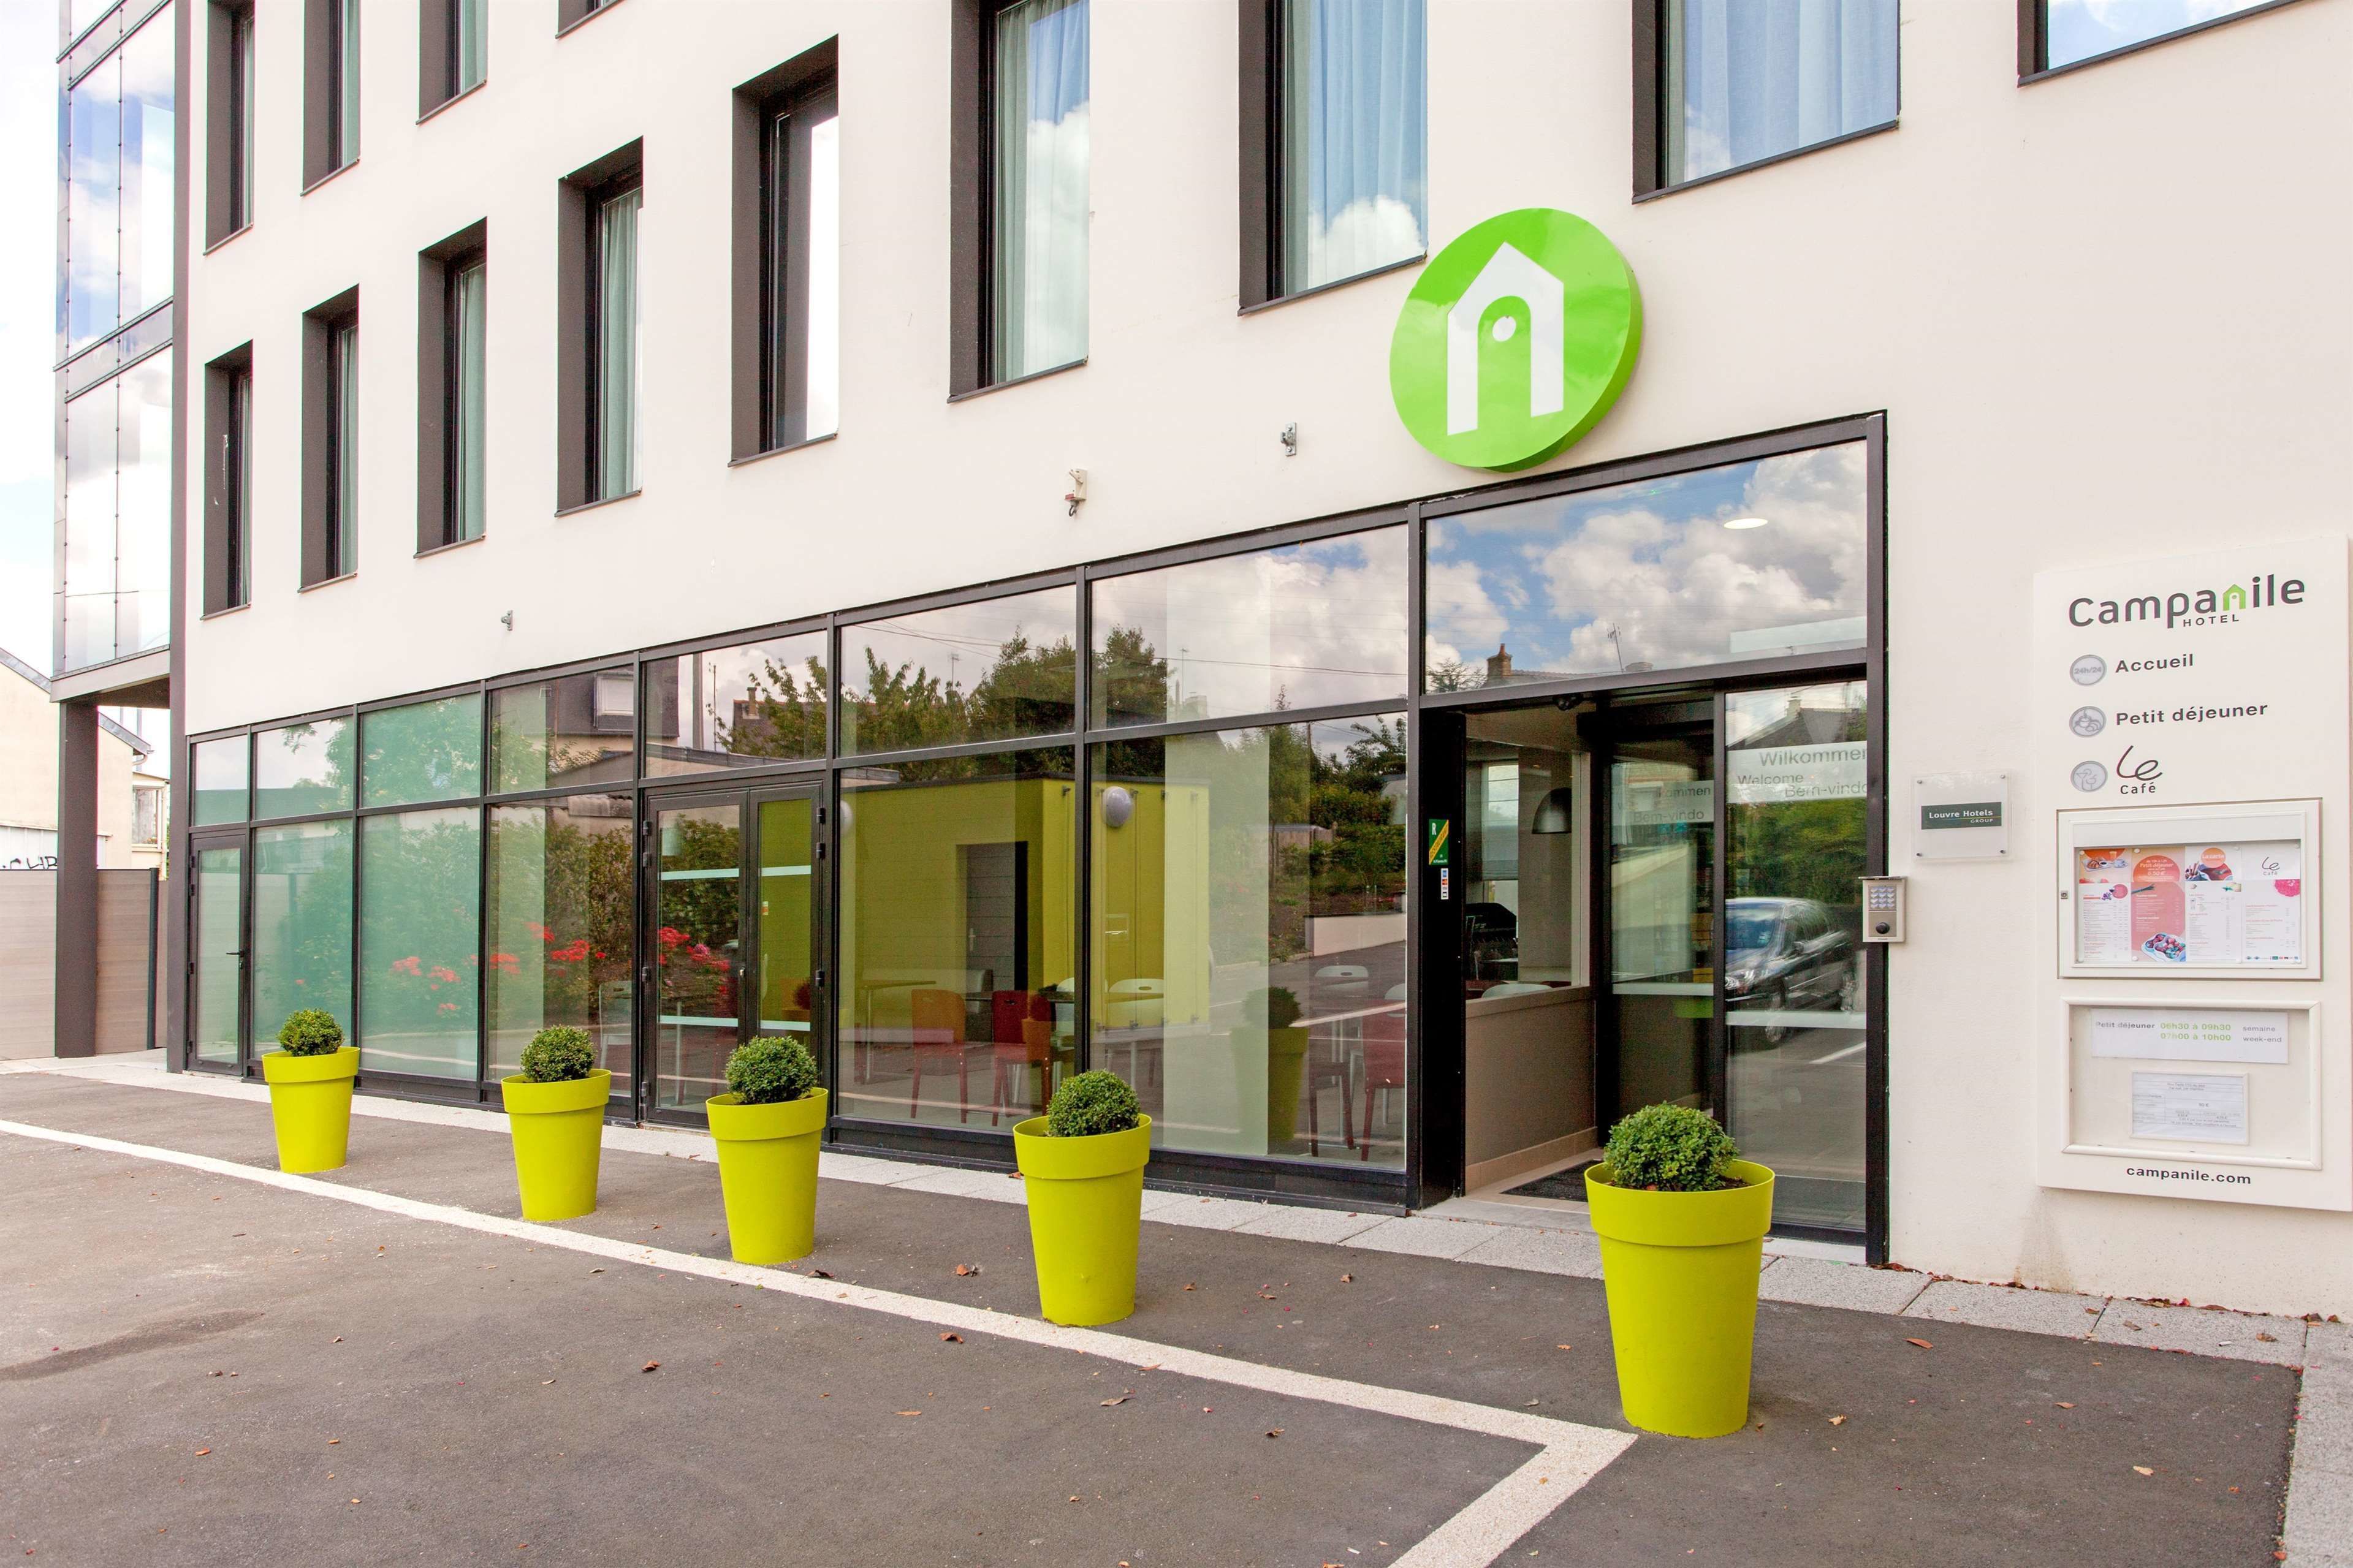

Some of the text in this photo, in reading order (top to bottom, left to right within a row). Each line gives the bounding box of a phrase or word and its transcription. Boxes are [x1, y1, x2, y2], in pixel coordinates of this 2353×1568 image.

[2069, 574, 2305, 629] Campanile
[2183, 614, 2240, 627] HOTEL
[2115, 654, 2194, 673] Accueil
[2116, 705, 2268, 725] Petit déjeuner
[2116, 744, 2163, 781] Le
[1738, 773, 1804, 785] Welcome
[2120, 782, 2156, 795] Café
[1633, 809, 1705, 822] Bem-vindo
[1432, 822, 1437, 835] R
[2126, 1166, 2251, 1184] campanile.com
